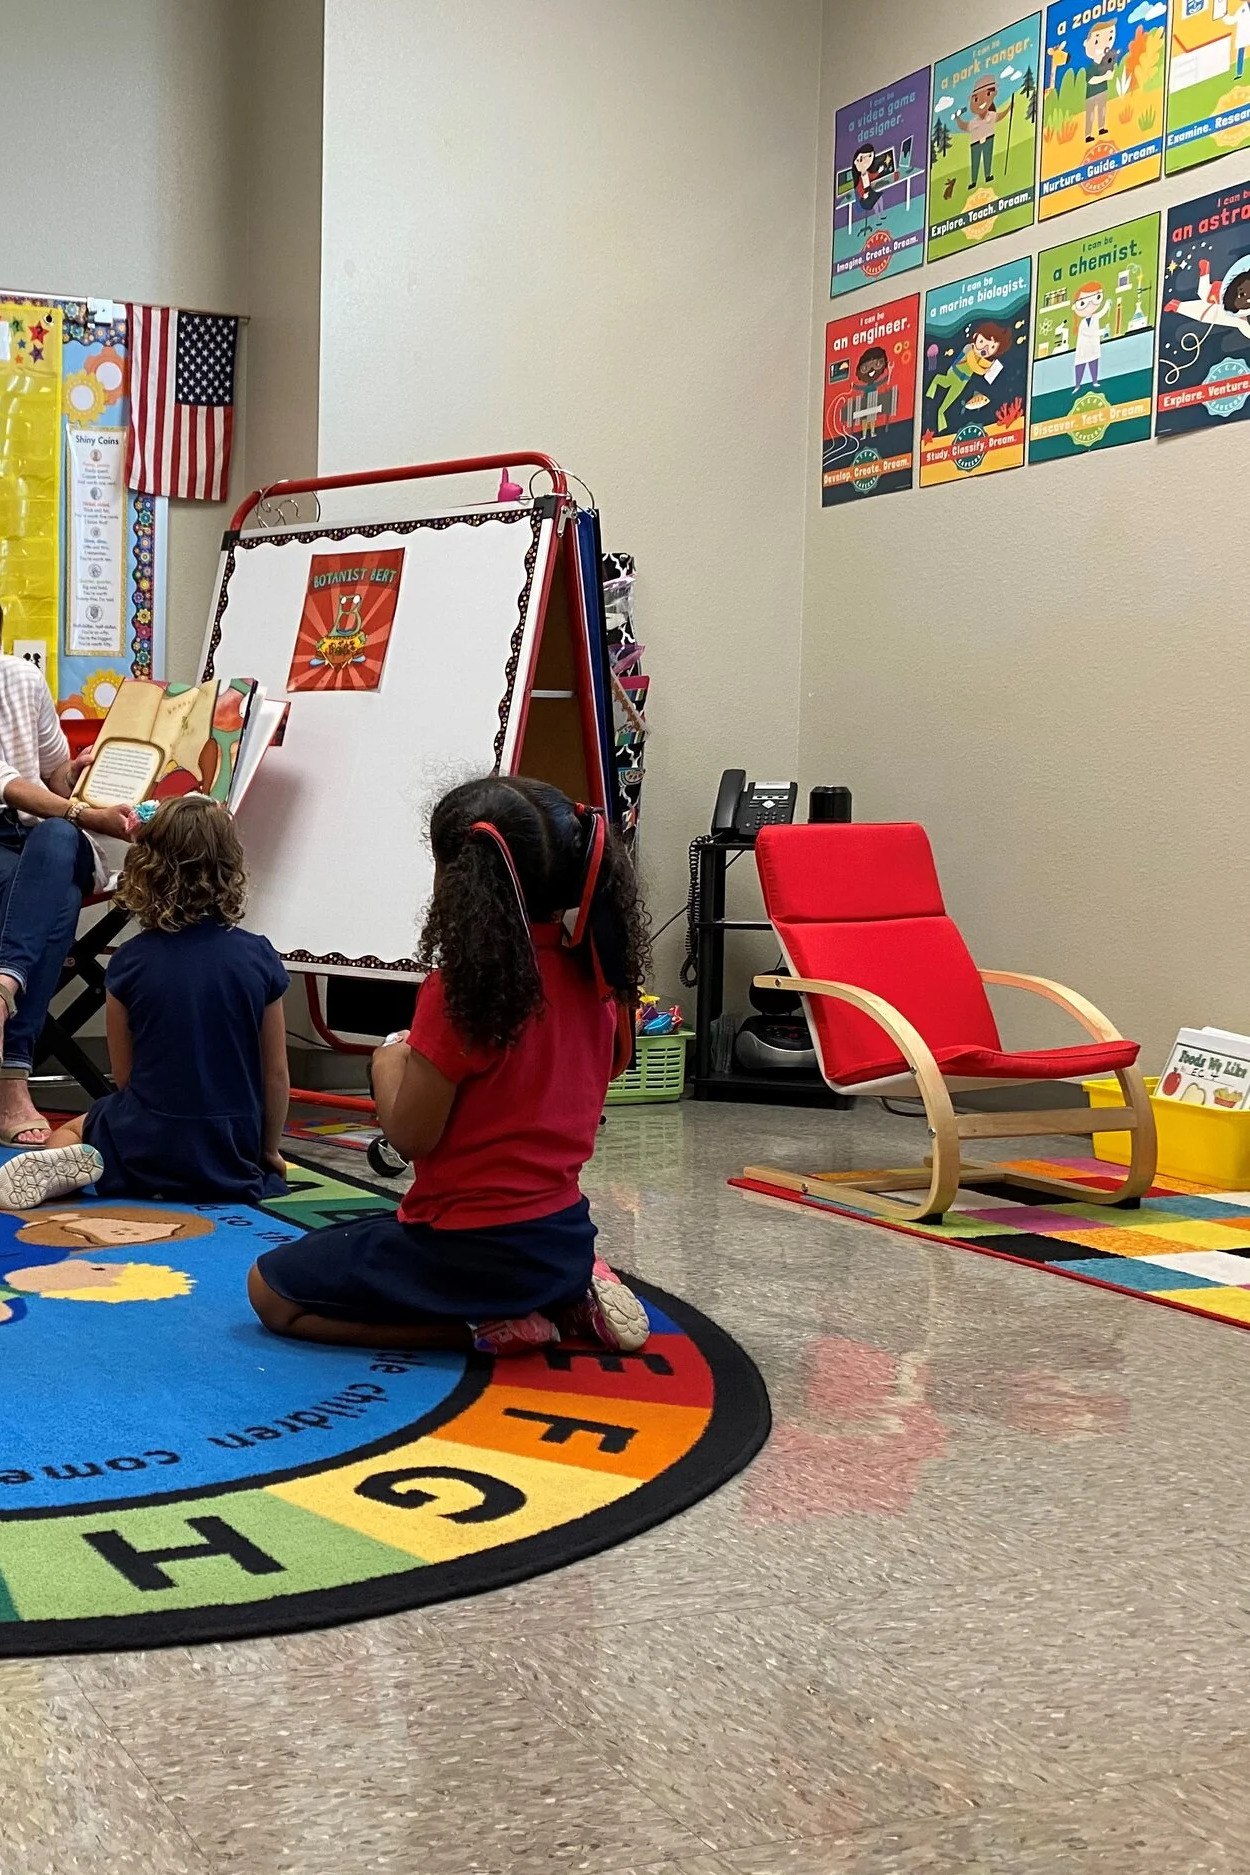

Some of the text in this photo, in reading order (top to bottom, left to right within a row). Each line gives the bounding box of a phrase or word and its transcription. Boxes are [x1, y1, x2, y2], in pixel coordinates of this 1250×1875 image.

[1071, 0, 1130, 29] zoolog
[952, 57, 981, 86] park
[986, 37, 1034, 70] ranger.
[857, 105, 885, 128] video
[887, 92, 917, 116] game
[857, 114, 905, 143] designer.
[1167, 109, 1250, 147] Examine. Resear
[1043, 144, 1159, 195] Nurture. Guide. Dream.
[931, 190, 1032, 238] Explore. Teach. Dream.
[1172, 204, 1250, 243] an astro
[836, 236, 919, 274] Imagine. Create. Dream.
[1069, 240, 1142, 279] chemist.
[939, 277, 1027, 315] marine biologist.
[833, 316, 911, 351] an engineer.
[1163, 391, 1205, 408] Explore.
[1033, 419, 1079, 438] Discover.
[1110, 403, 1146, 419] Dream.
[75, 434, 119, 447] Shiny Coins
[926, 434, 1016, 463] Study. Classify. Dream.
[854, 463, 881, 478] Create.
[883, 458, 910, 472] Dream.
[313, 567, 397, 589] BOTANIST BERT
[207, 1380, 390, 1451] children
[501, 1407, 640, 1455] F
[354, 1466, 527, 1525] G
[82, 1515, 288, 1592] H
